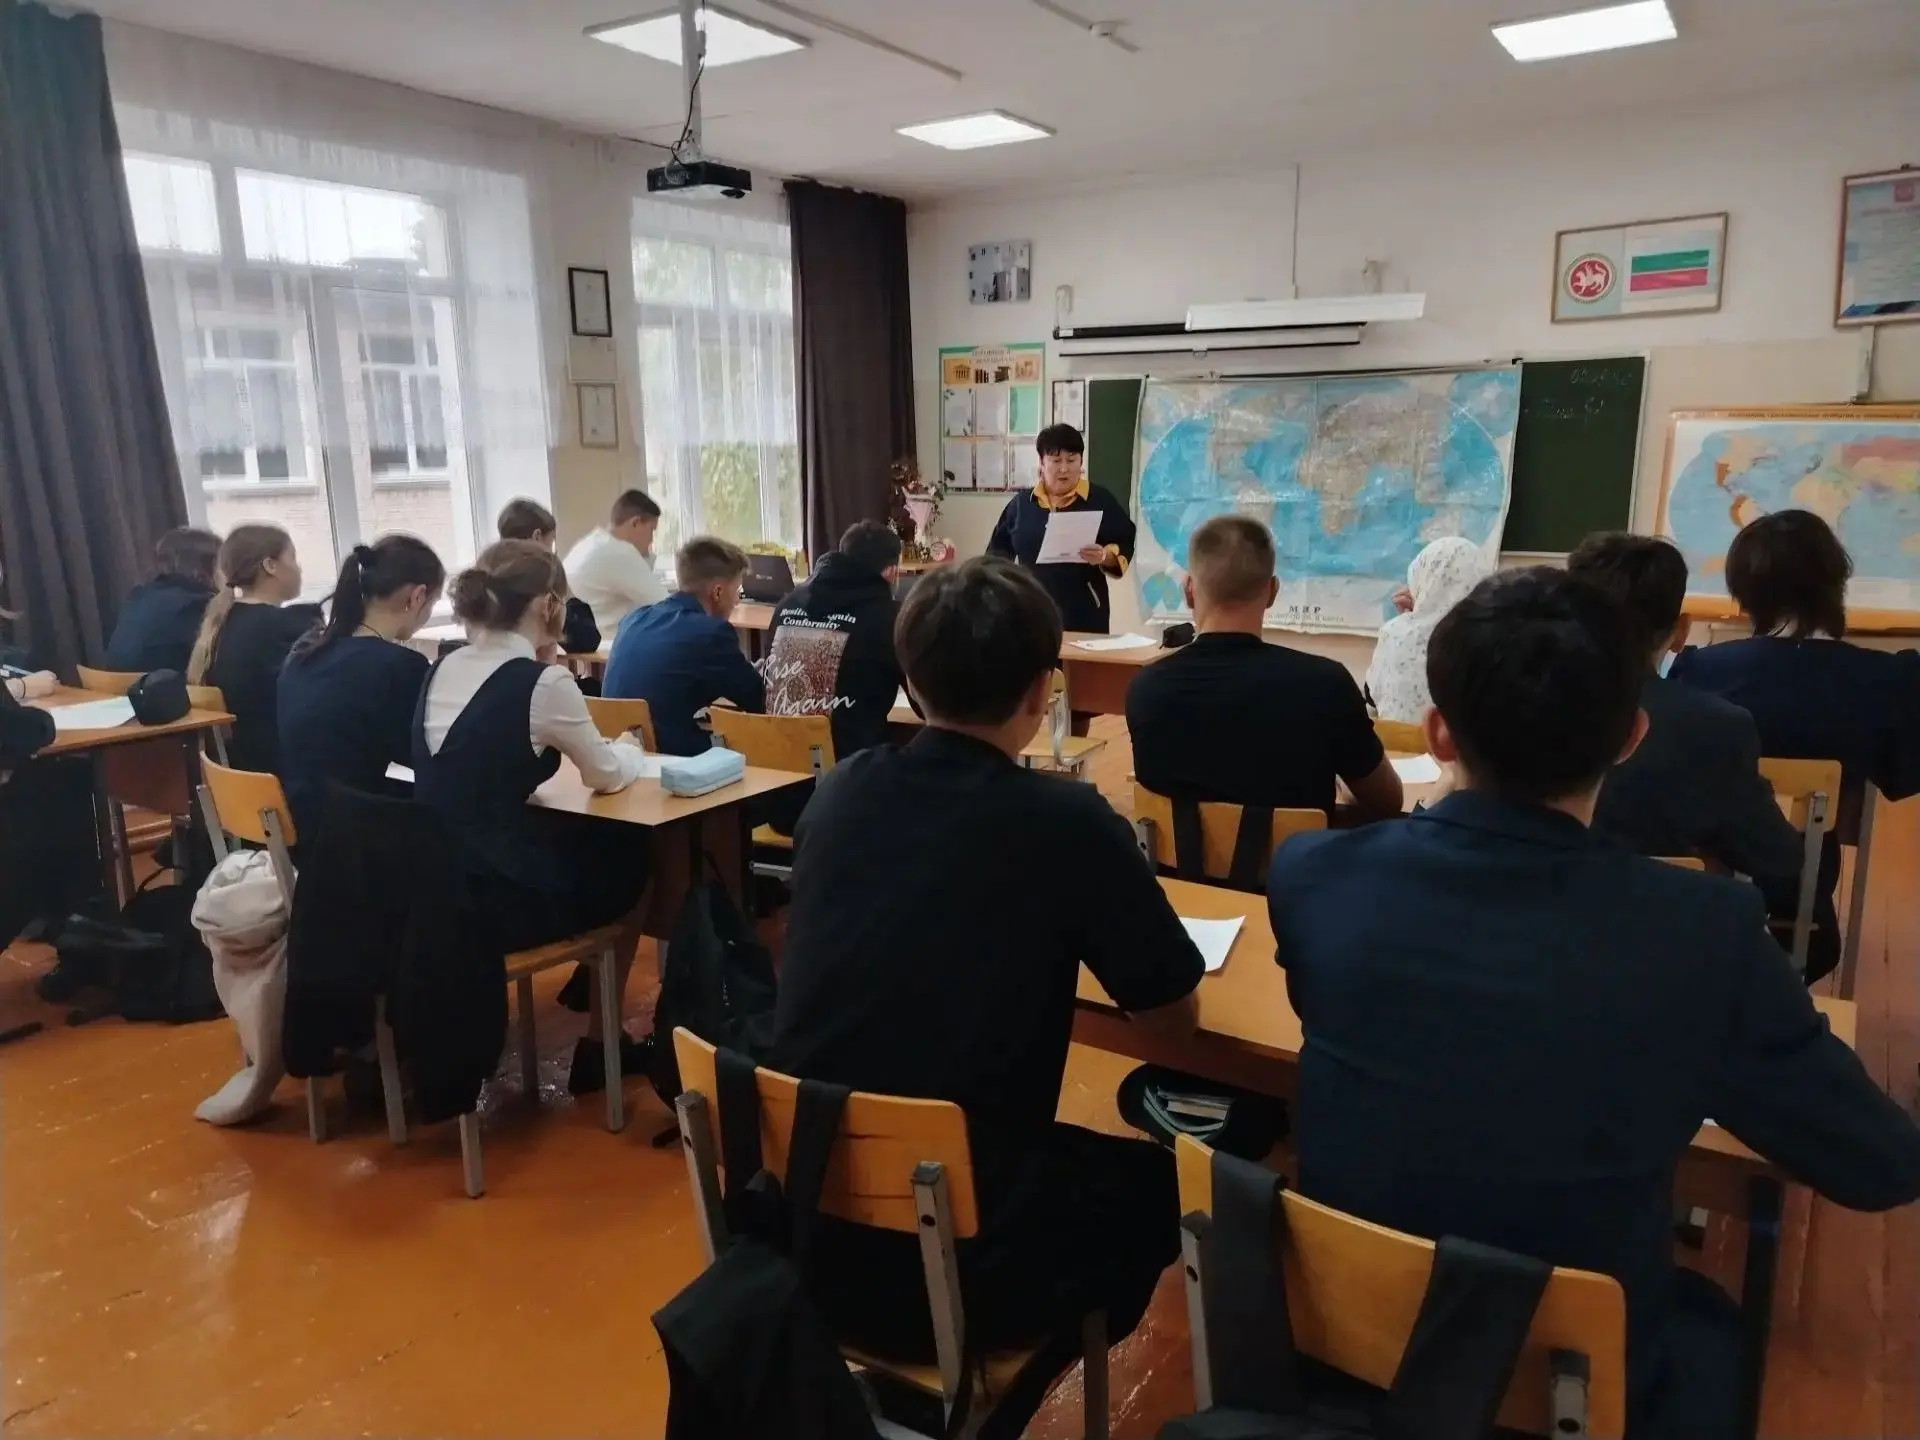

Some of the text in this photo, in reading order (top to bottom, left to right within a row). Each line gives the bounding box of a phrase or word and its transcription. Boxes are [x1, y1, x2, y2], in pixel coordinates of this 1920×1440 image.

[783, 617, 840, 629] Conformity
[763, 654, 805, 687] Rise
[774, 687, 856, 716] Again
